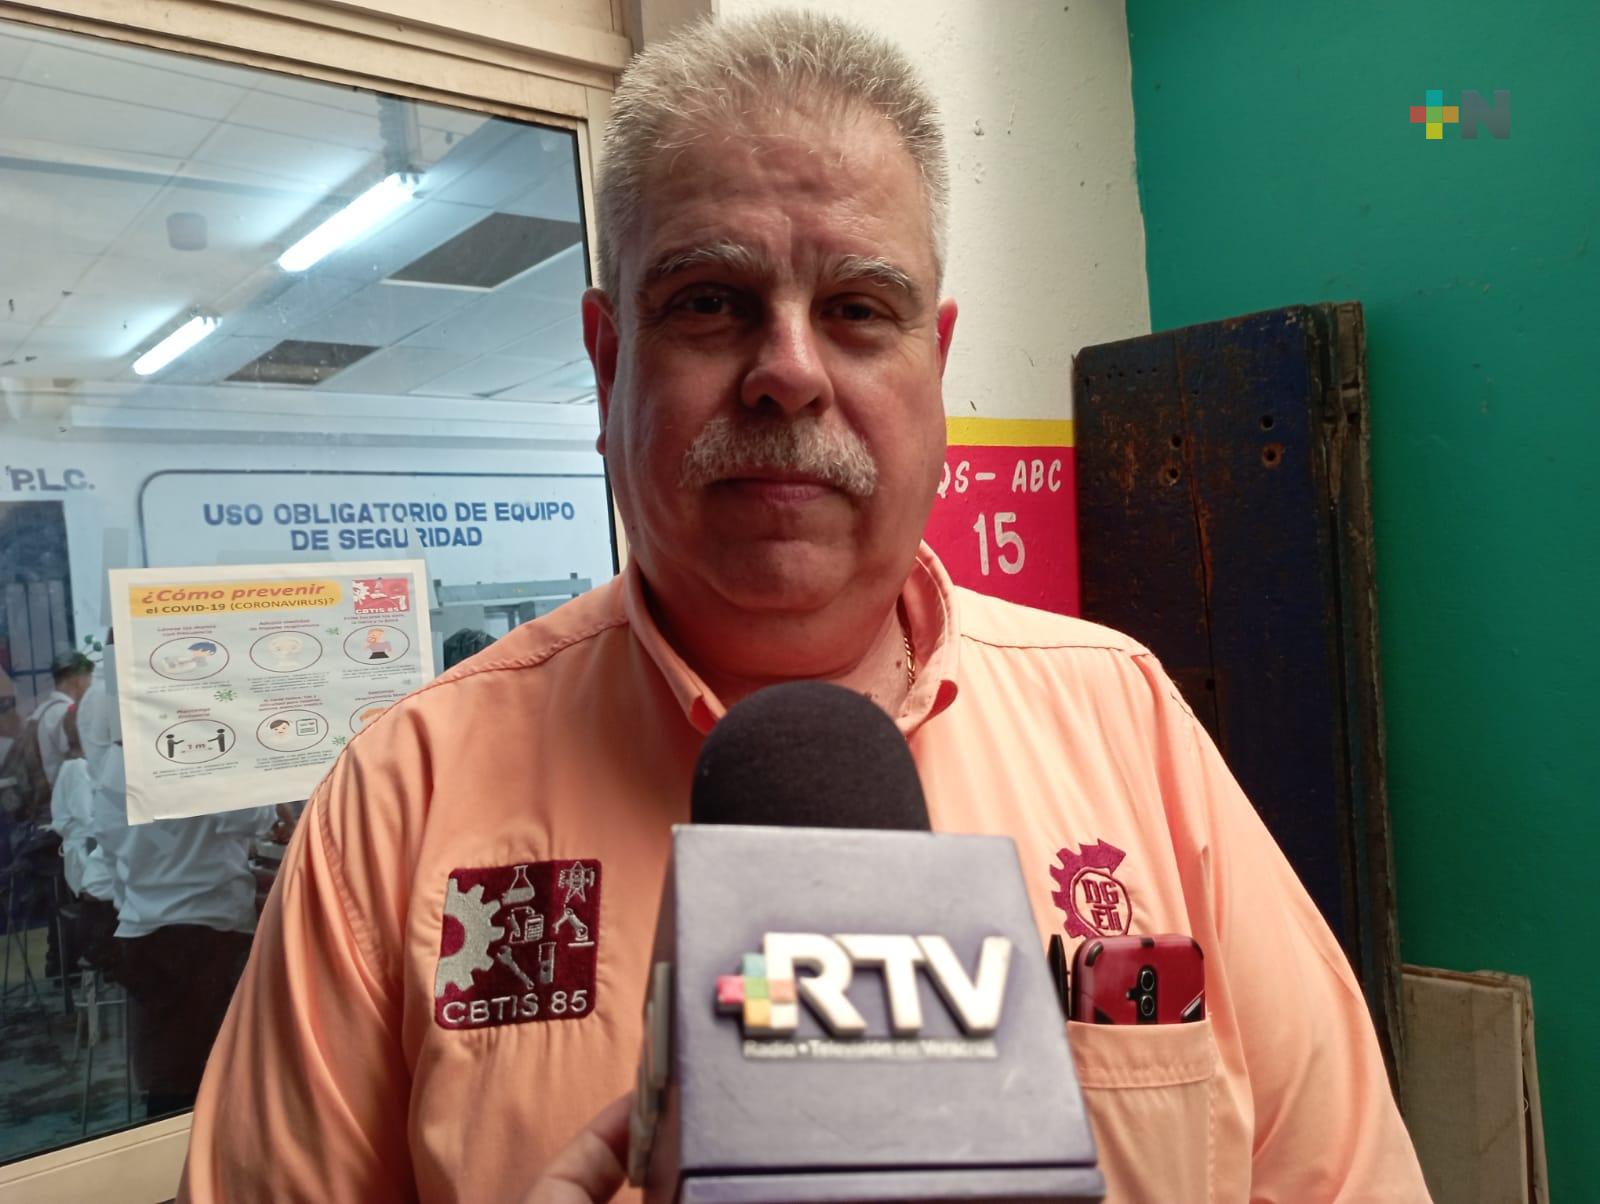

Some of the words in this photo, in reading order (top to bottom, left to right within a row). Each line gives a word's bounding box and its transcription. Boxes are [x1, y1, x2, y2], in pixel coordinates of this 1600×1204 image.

[1011, 459, 1062, 493] ABC
[203, 503, 263, 526] USO
[273, 502, 448, 525] OBLIGATORIO
[455, 502, 488, 522] DE
[494, 501, 575, 523] EQUIPO
[291, 529, 330, 552] DE
[339, 526, 483, 550] SEGURIDAD
[973, 511, 1026, 577] 15
[142, 588, 225, 604] ¿Cómo
[231, 583, 326, 601] prevenir
[146, 605, 158, 615] el
[162, 603, 226, 614] COVID-19
[230, 597, 335, 612] (CORONAVIRUS)?
[763, 931, 1012, 1031] RTV
[443, 993, 539, 1024] CBTIS
[551, 990, 588, 1014] 85
